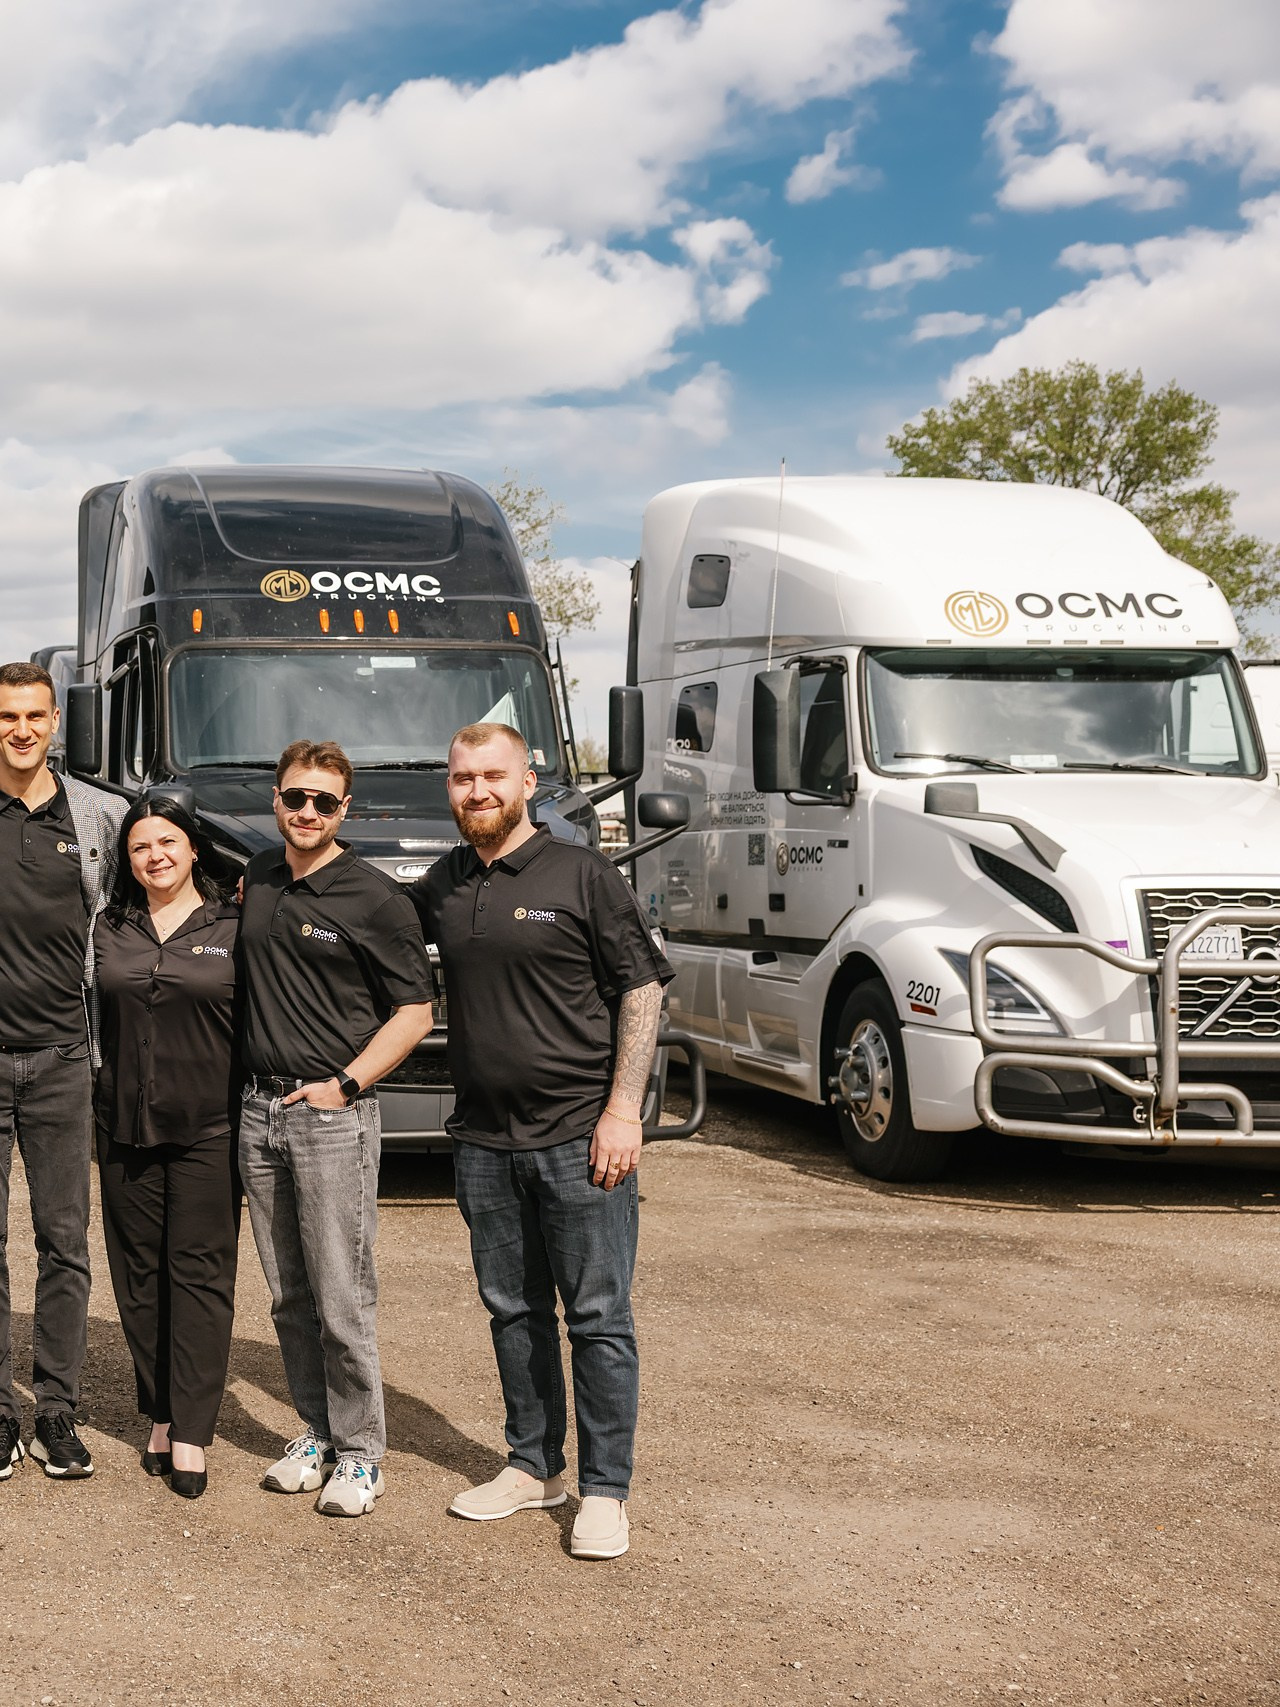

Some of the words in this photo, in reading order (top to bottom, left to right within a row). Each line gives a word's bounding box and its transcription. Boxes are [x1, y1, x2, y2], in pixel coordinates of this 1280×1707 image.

[310, 571, 441, 596] OCMC
[312, 593, 445, 603] TRUCKING
[1015, 592, 1183, 619] OCMC
[1022, 624, 1191, 633] TRUCKING
[790, 846, 823, 864] OCMC
[528, 909, 555, 918] OCMC
[313, 928, 338, 939] OCMC
[1183, 936, 1238, 953] 122771
[906, 980, 941, 1006] 2201
